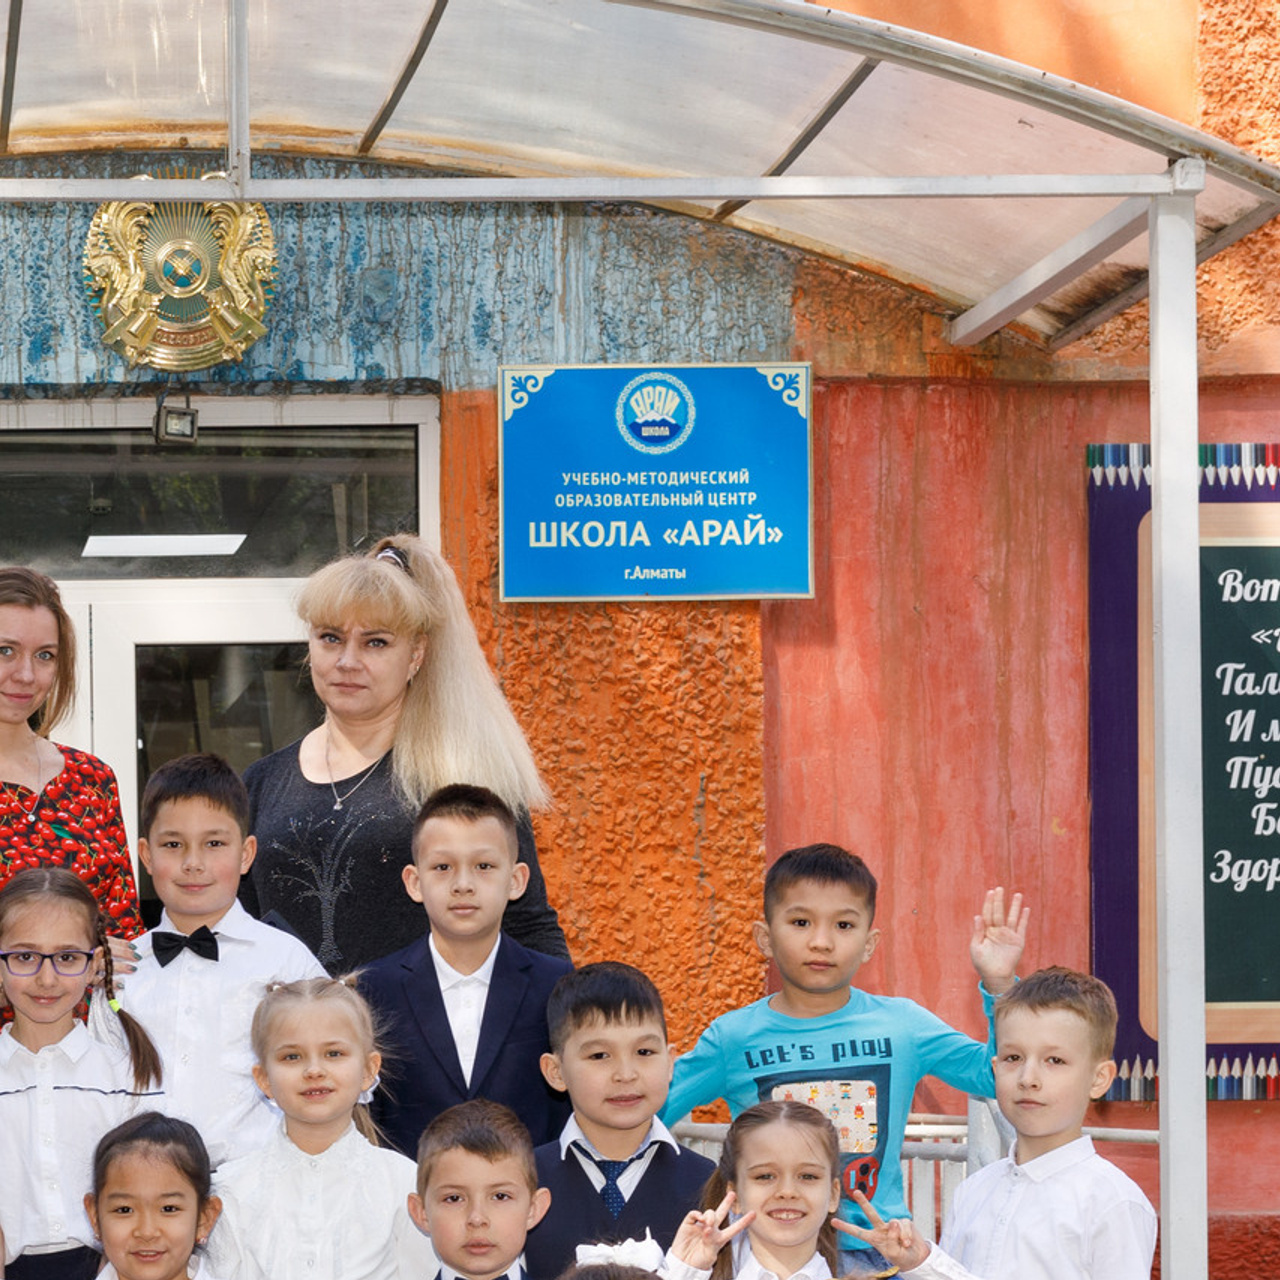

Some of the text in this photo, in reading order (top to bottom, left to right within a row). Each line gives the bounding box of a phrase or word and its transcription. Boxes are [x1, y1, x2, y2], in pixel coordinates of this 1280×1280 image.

[562, 468, 750, 486] УЧЕБНО-МЕТОДИЧЕСКИЙ
[554, 490, 757, 508] ОБРАЗОВАТЕЛЬНЫЙ ЦЕНТР
[528, 513, 784, 548] ШКОЛА «АРАЙ»
[624, 566, 687, 580] г.Алматы
[744, 1037, 893, 1070] Let's play
